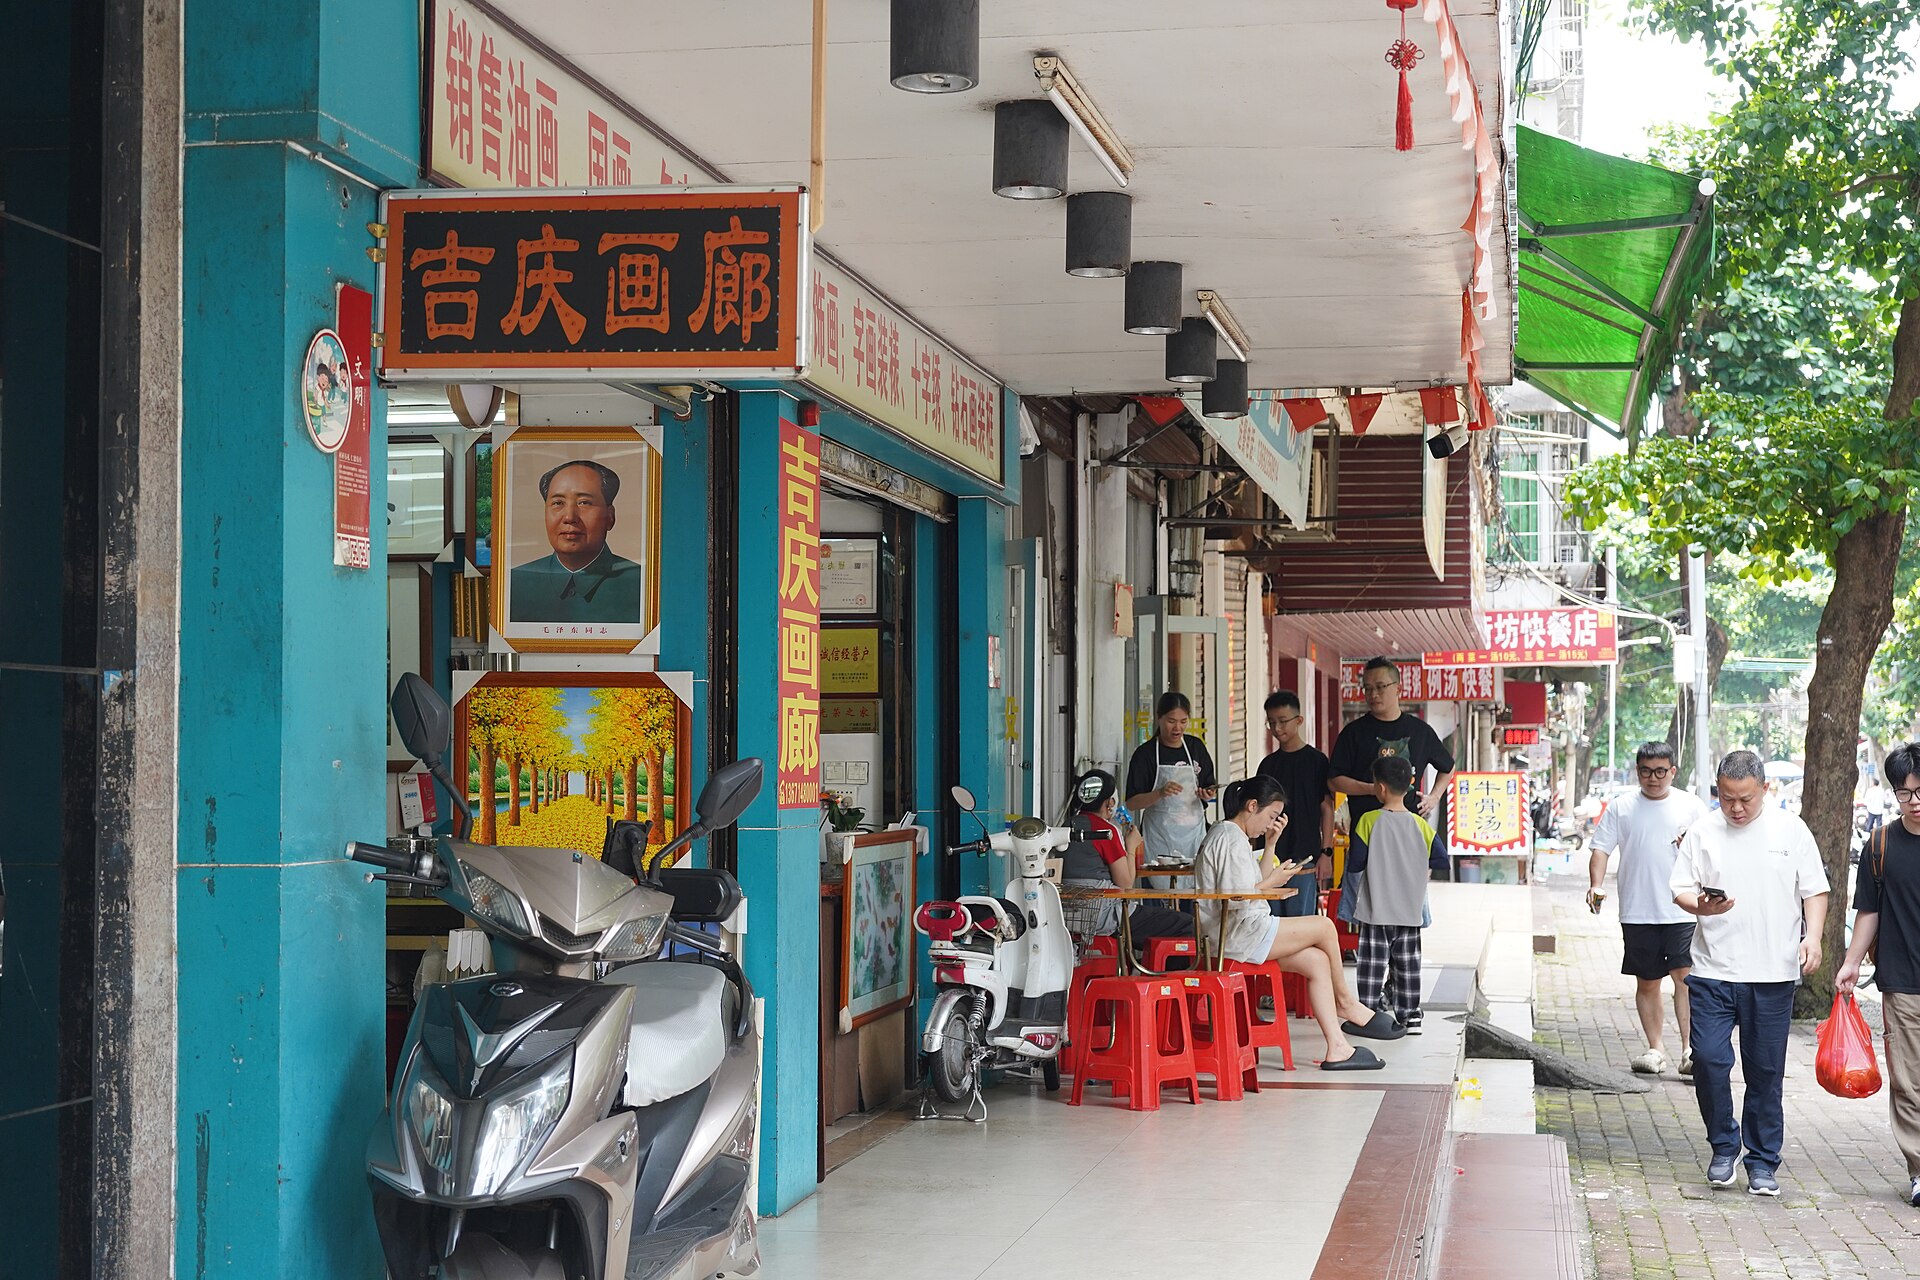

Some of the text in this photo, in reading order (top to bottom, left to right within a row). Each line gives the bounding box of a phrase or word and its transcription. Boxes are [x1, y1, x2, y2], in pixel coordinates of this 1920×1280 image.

[410, 215, 771, 345] 吉庆画廊
[353, 355, 364, 407] 文明
[543, 626, 608, 634] 毛泽东同志
[780, 435, 819, 776] 吉庆画廊
[1427, 668, 1458, 699] 例汤
[1462, 667, 1493, 698] 快餐
[1475, 780, 1501, 832] 牛骨汤
